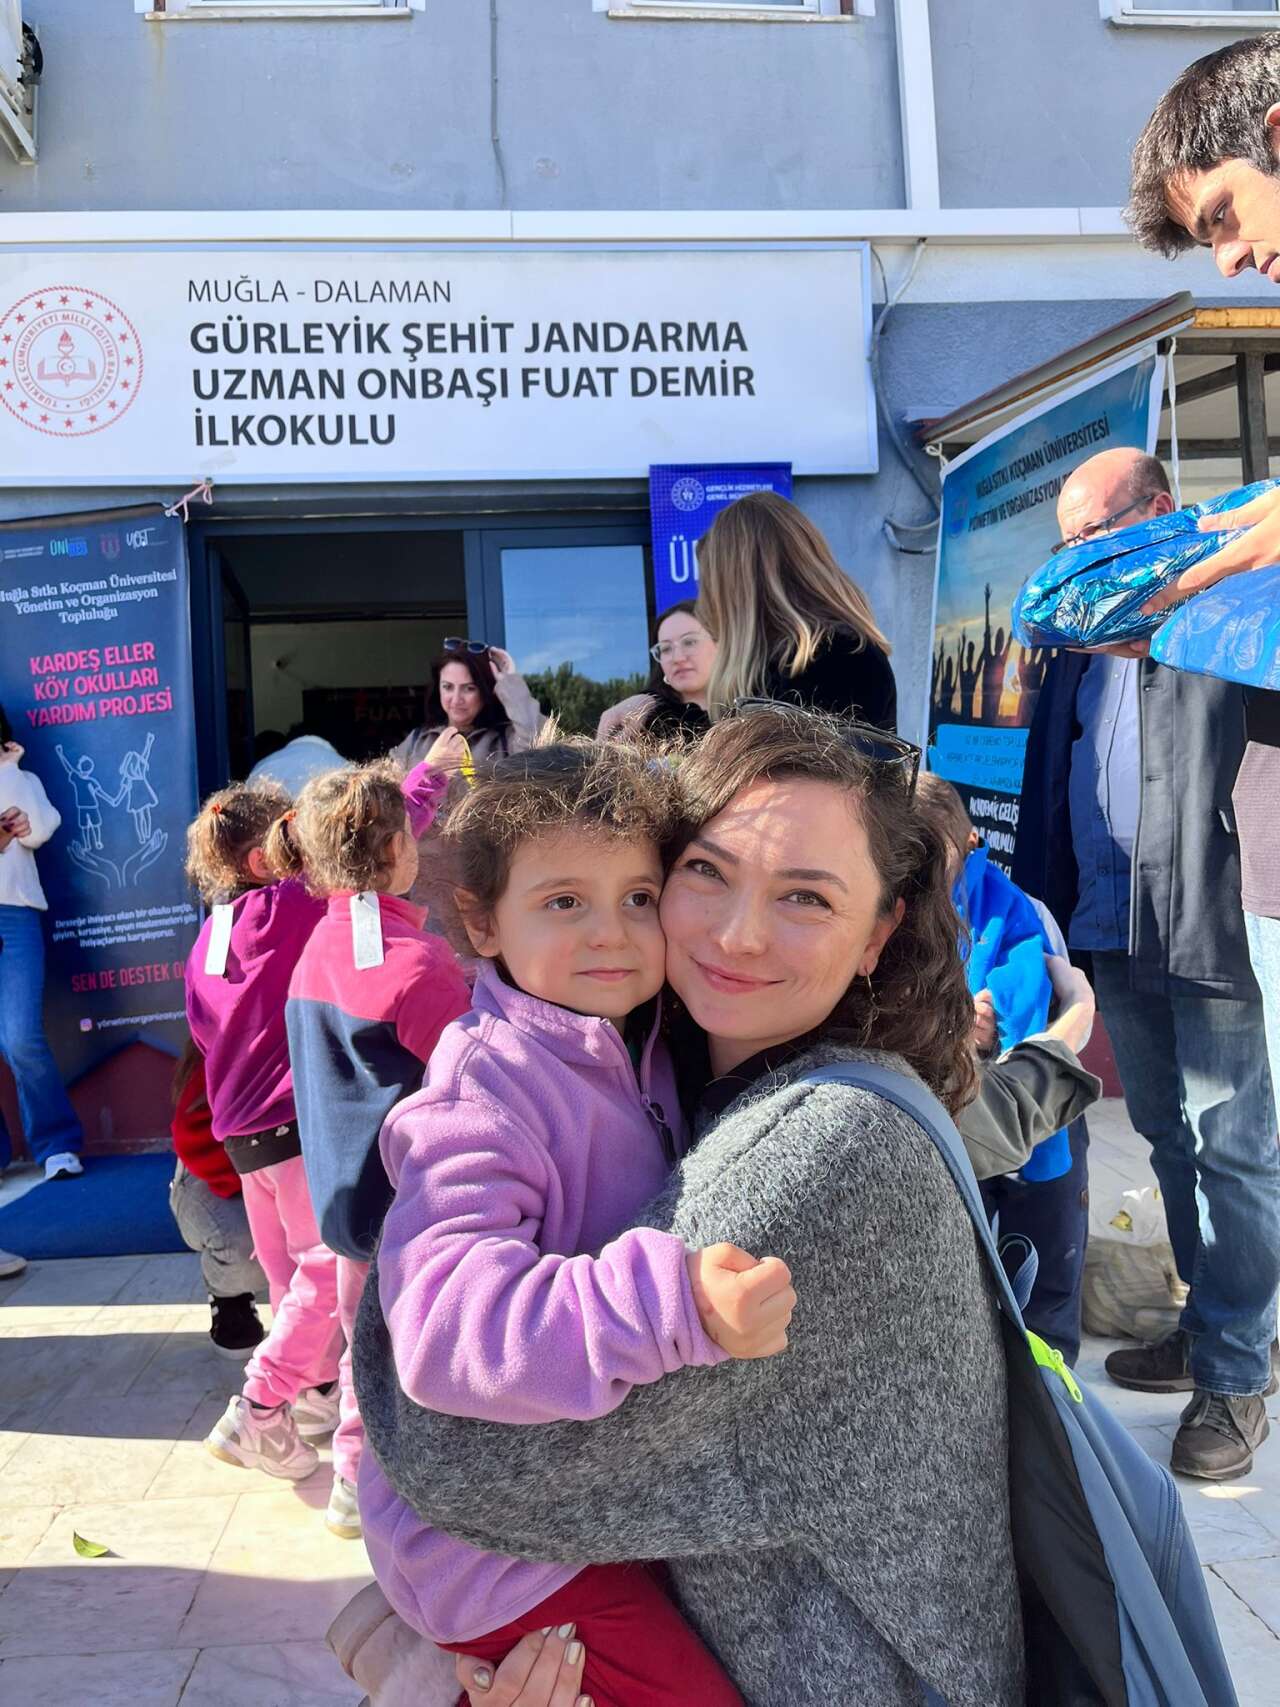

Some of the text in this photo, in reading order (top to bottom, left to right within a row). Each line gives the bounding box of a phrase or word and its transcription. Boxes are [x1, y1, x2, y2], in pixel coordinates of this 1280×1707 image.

[188, 275, 289, 303] MUĞLA
[314, 280, 452, 303] DALAMAN
[61, 313, 91, 327] MİLLİ
[190, 315, 749, 362] GÜRLEYİK ŞEHİT JANDARMA
[193, 359, 756, 407] UZMAN ONBAŞI FUAT DEMİR
[194, 407, 397, 446] İLKOKULU
[1044, 412, 1110, 463] ÜNİVERSİTESİ
[1007, 481, 1061, 518] ORGANİZASYON
[31, 583, 58, 598] Sıtkı
[60, 578, 107, 594] Koçman
[109, 568, 177, 588] Üniversitesi
[14, 587, 158, 615] Yönetim ve Organizasyon
[58, 606, 118, 624] Topluluğu
[29, 642, 156, 675] KARDEŞ ELLER
[34, 667, 159, 701] KÖY OKULLARI
[27, 686, 173, 728] YARDIM PROJESİ
[71, 972, 97, 993] SEN
[100, 969, 117, 990] DE
[119, 961, 170, 987] DESTEK
